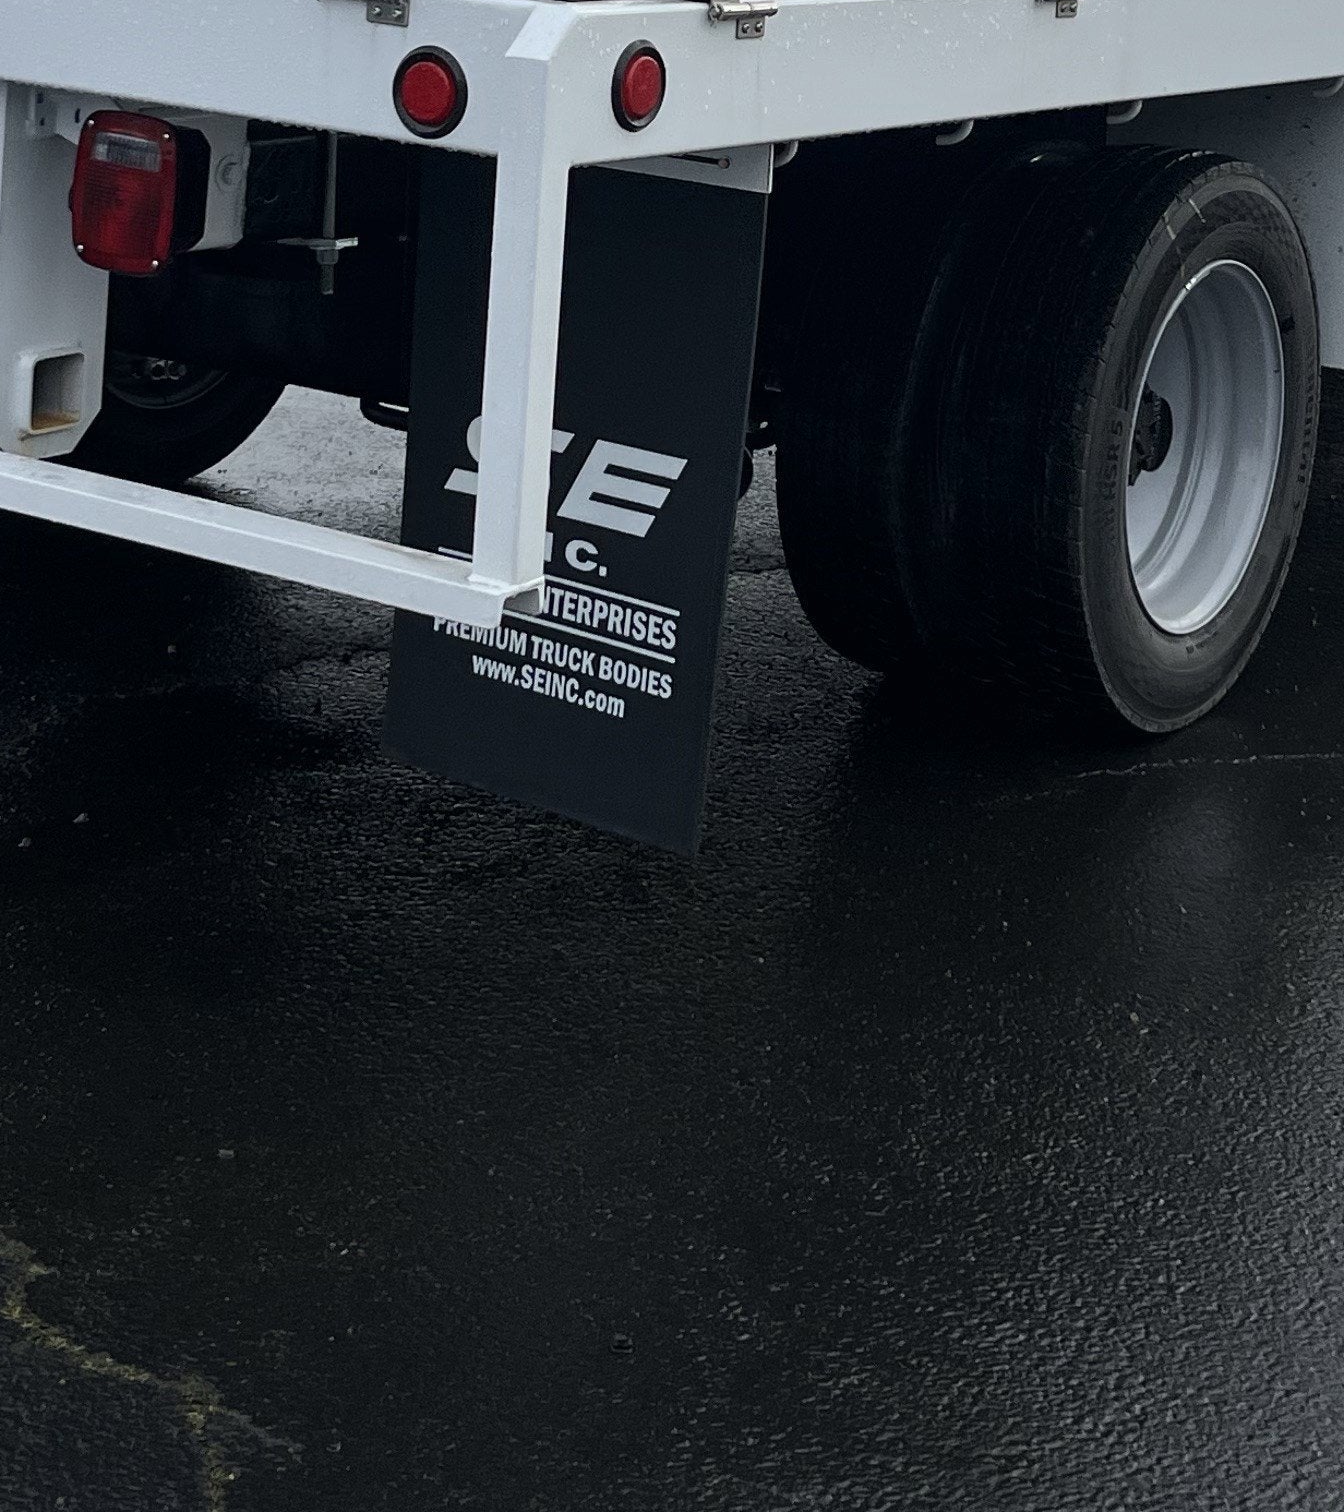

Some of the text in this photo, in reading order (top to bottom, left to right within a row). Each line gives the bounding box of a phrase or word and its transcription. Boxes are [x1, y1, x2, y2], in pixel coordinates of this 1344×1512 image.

[433, 616, 673, 699] PREMIUM TRUCK BODIES
[472, 654, 625, 718] www.SEINC.com
